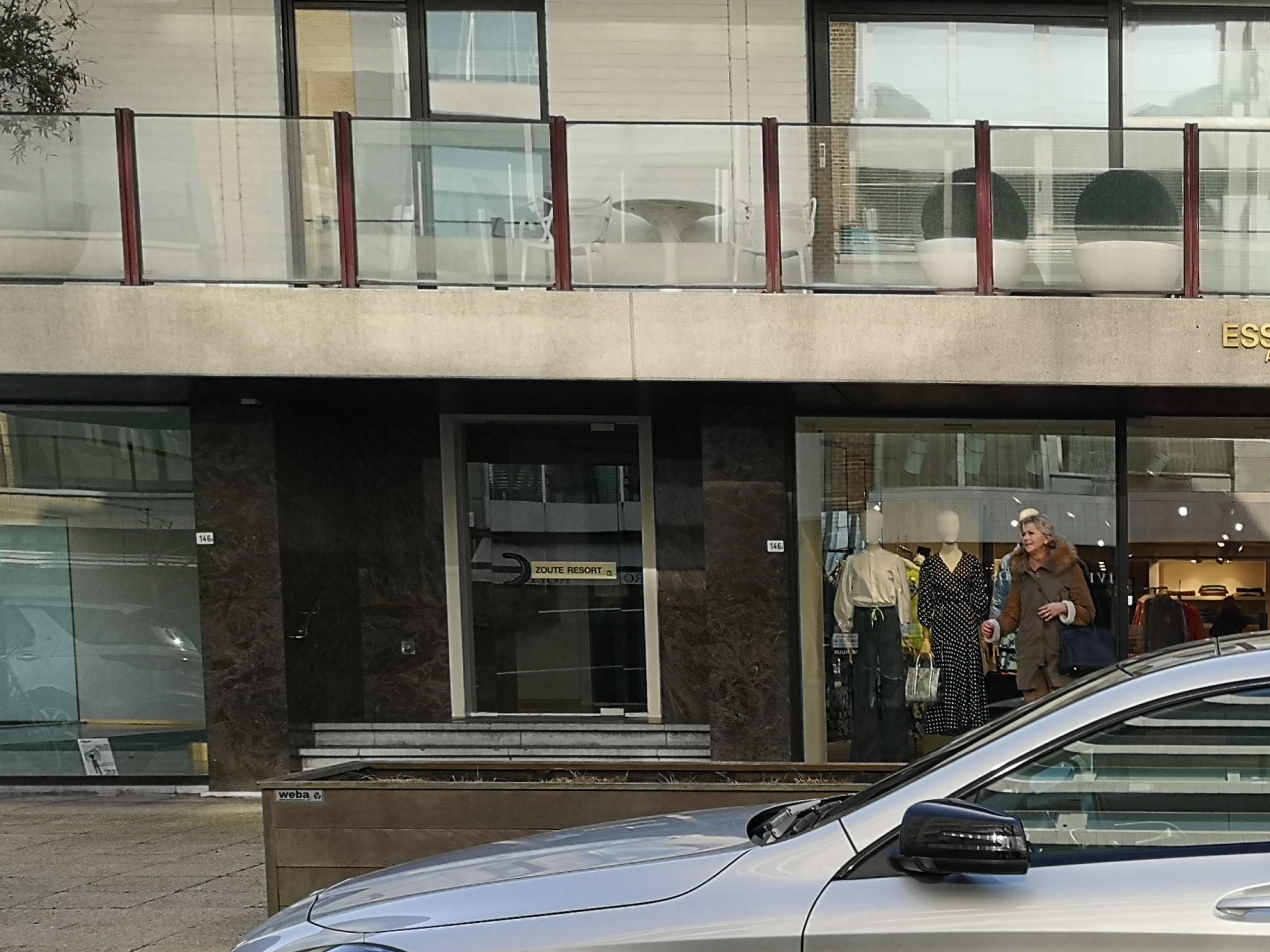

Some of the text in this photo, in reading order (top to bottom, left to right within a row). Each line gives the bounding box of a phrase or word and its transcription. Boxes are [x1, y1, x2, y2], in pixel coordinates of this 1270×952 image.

[535, 566, 602, 574] ZOUTE RESORT
[278, 791, 310, 799] weba
